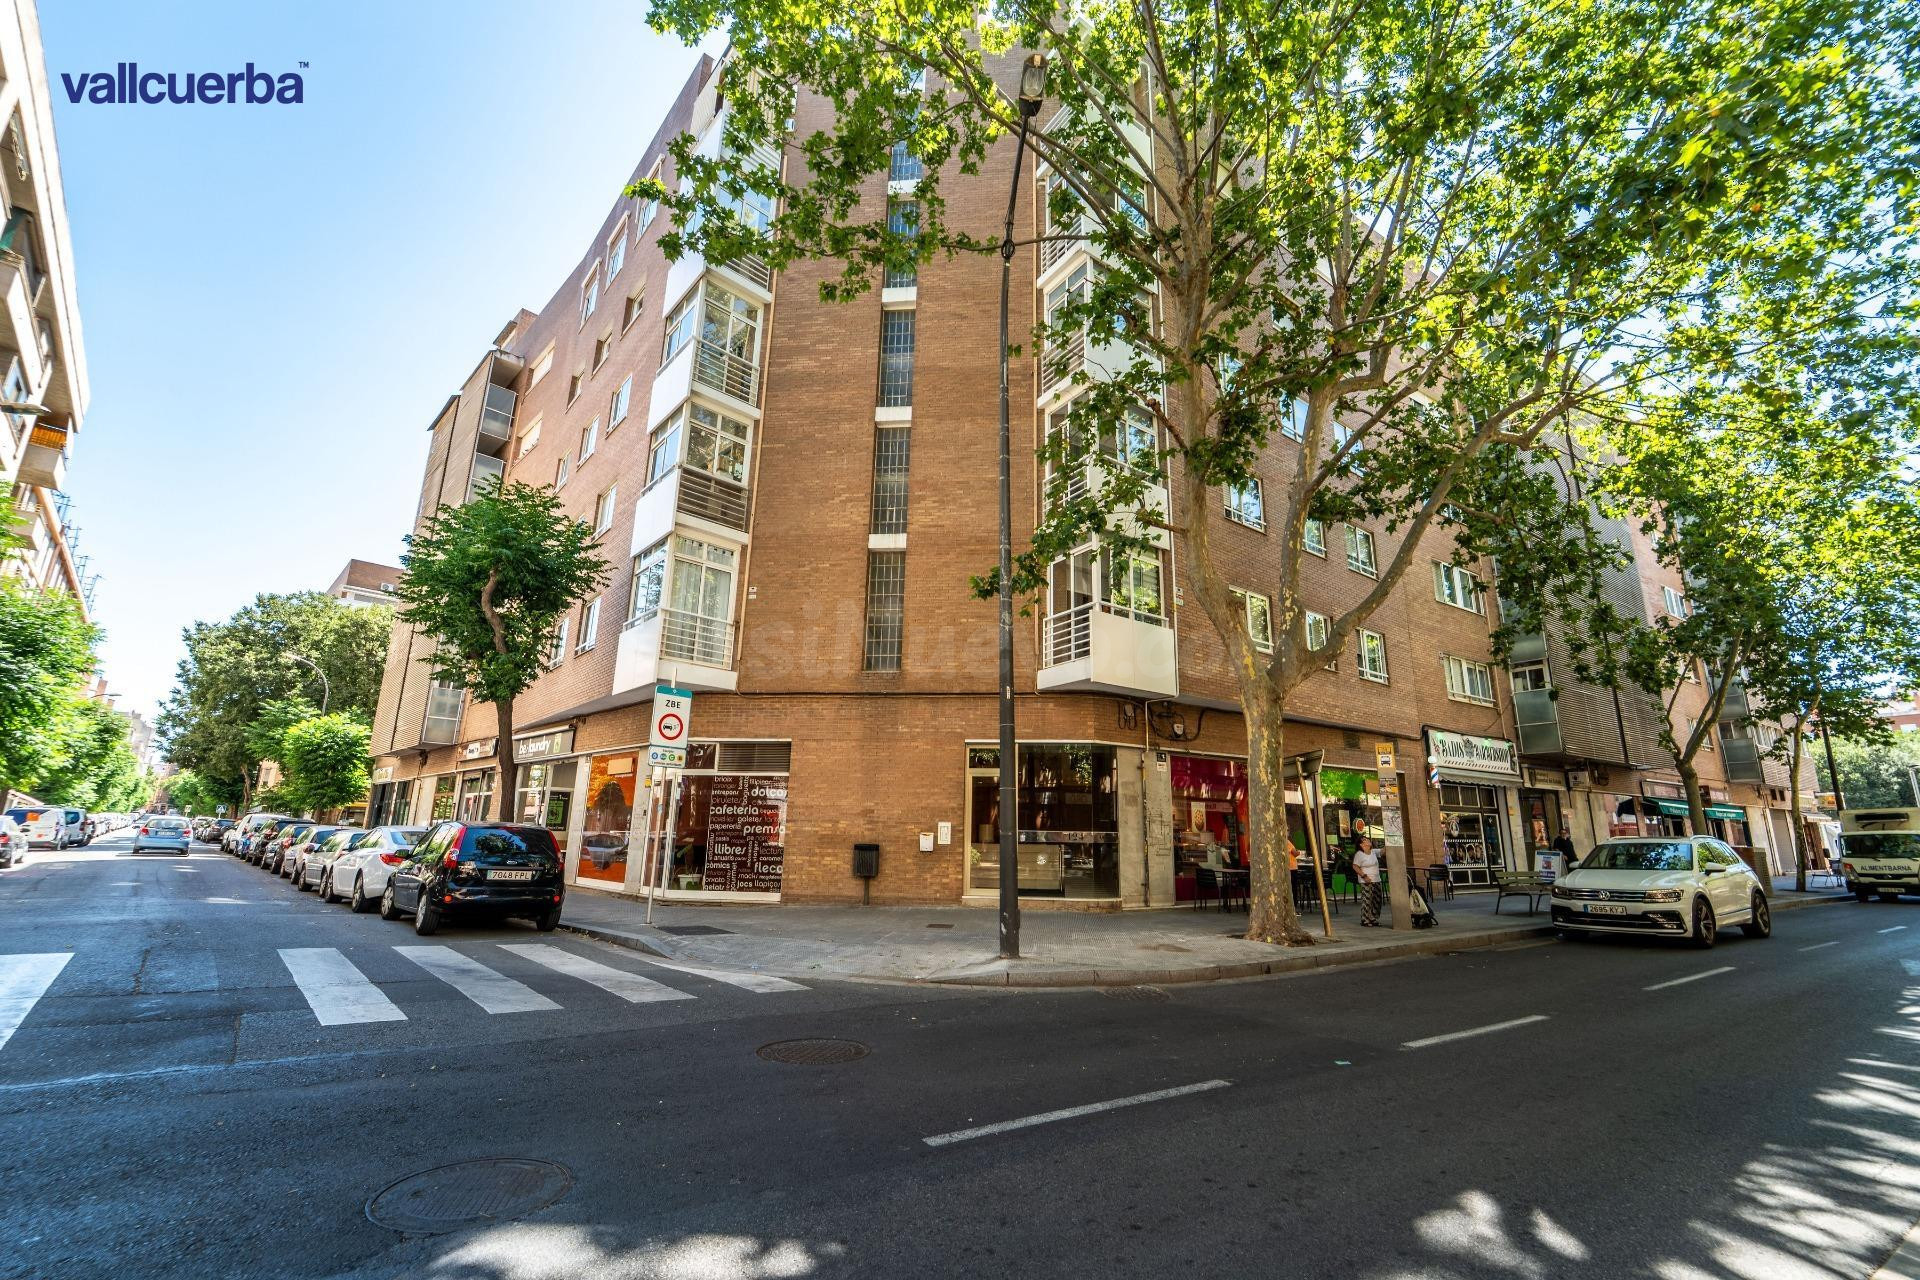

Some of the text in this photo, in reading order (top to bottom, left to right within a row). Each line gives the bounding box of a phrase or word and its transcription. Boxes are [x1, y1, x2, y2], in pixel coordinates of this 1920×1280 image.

[665, 699, 682, 708] ZBE
[710, 804, 759, 815] cafeteria
[743, 825, 786, 836] premsa
[714, 843, 746, 854] llibres
[754, 862, 784, 873] fleca
[493, 871, 530, 880] 7048 FPL
